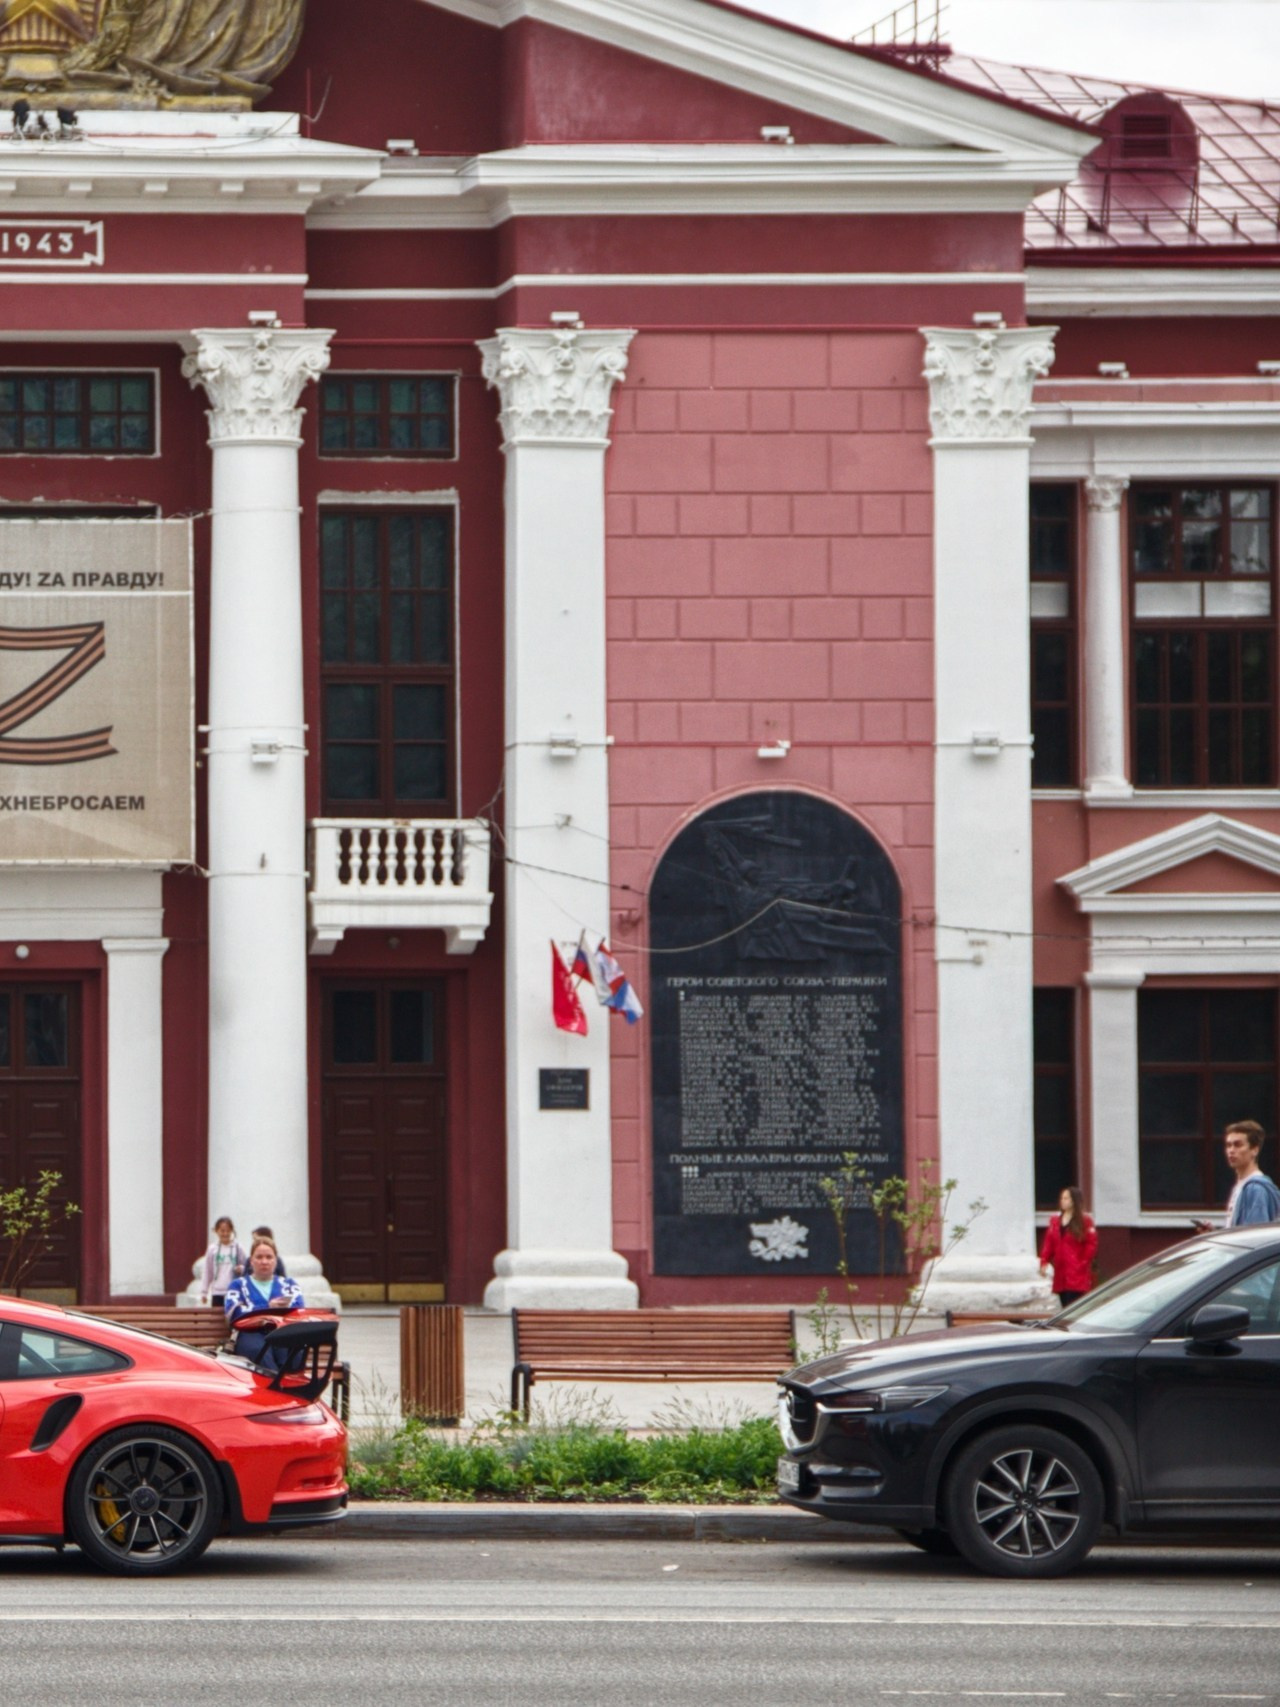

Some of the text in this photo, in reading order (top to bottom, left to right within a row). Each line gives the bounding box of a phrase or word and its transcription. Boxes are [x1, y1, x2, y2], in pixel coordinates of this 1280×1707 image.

[2, 232, 74, 253] 1943
[72, 572, 164, 589] ПРАВДУ!
[667, 977, 703, 987] ГЕРОИ
[707, 977, 778, 987] СОВЕТСКОГО
